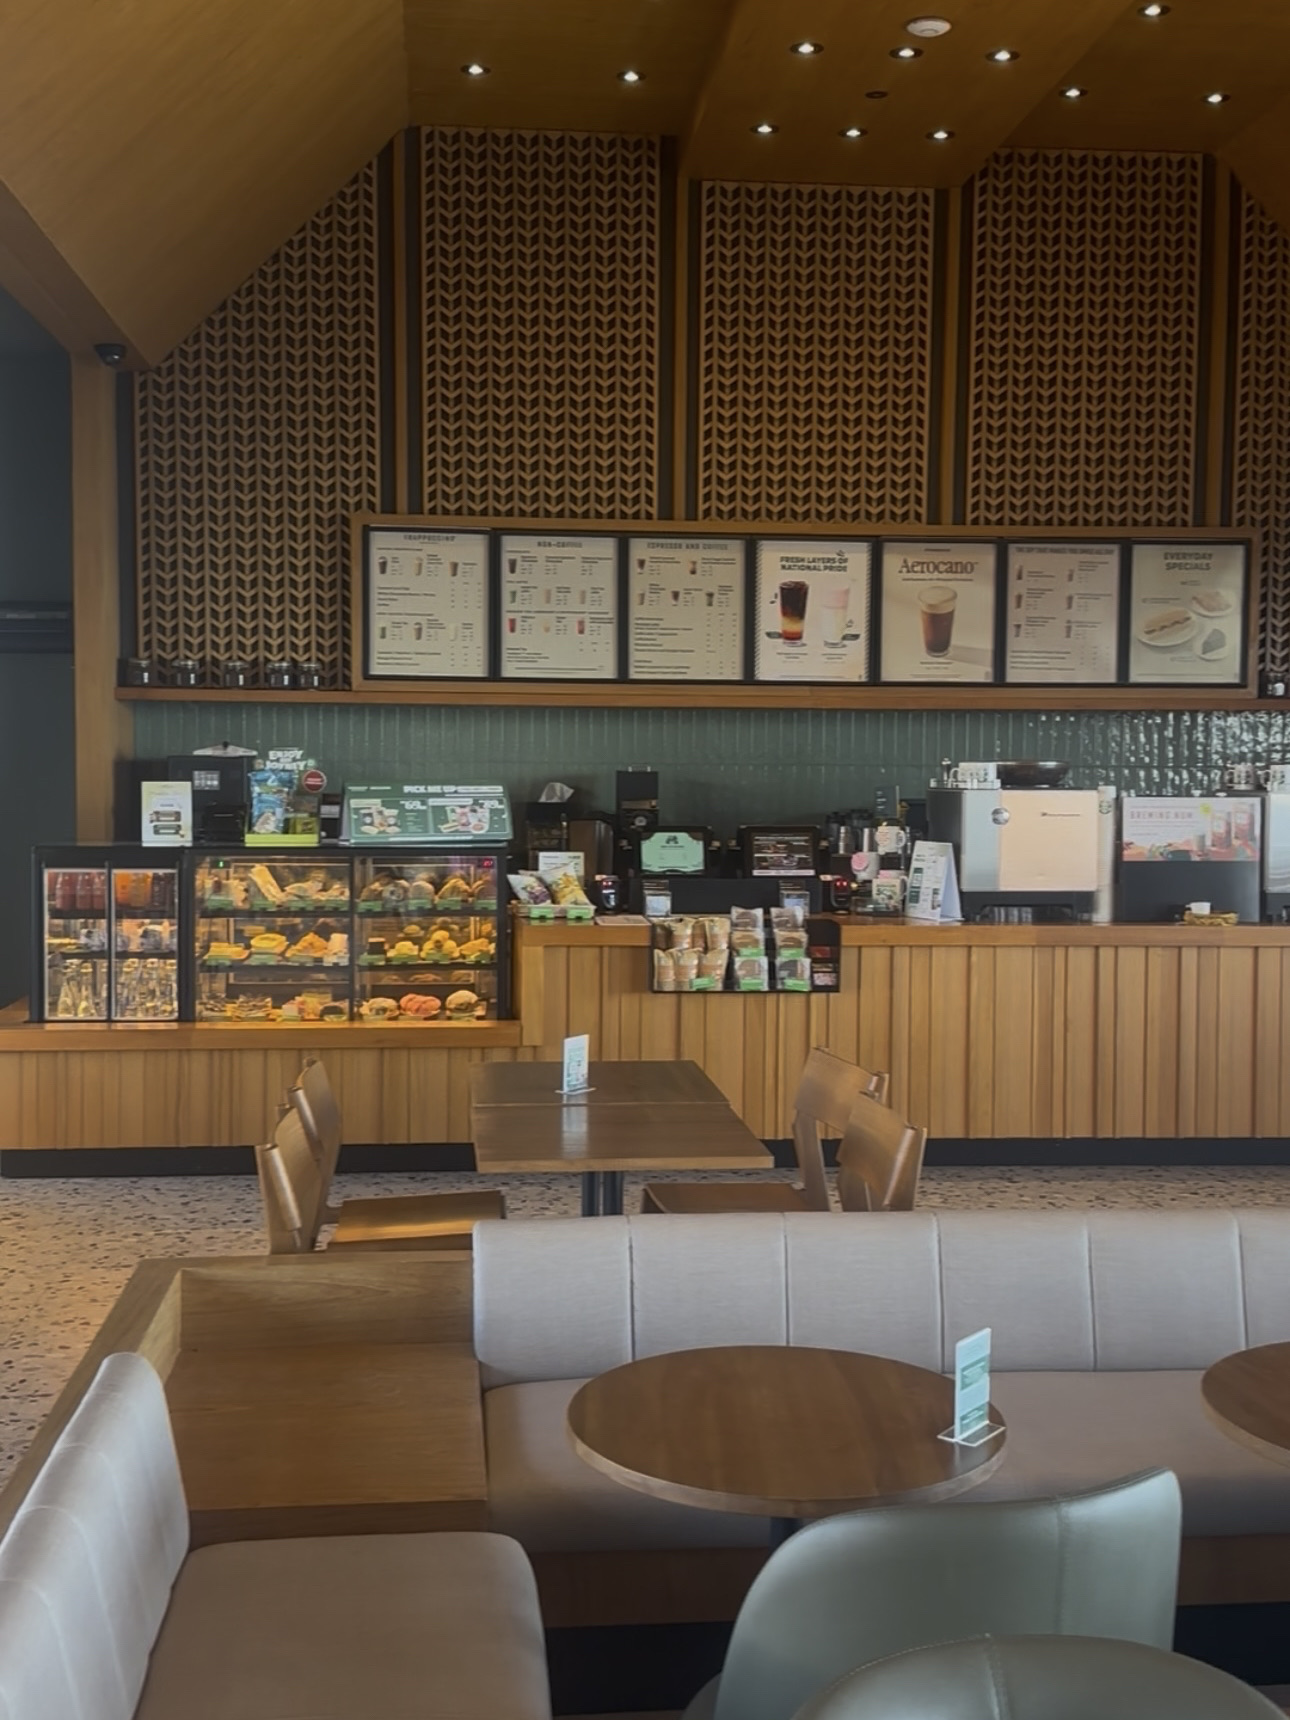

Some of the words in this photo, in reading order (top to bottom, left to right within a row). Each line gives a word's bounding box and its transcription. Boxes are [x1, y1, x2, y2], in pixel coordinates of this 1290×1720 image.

[807, 556, 837, 564] LAYERS
[1164, 552, 1213, 560] EVERYDAY
[898, 557, 975, 574] Aerocano
[1165, 562, 1212, 570] SPECIALS
[403, 785, 426, 793] PICK
